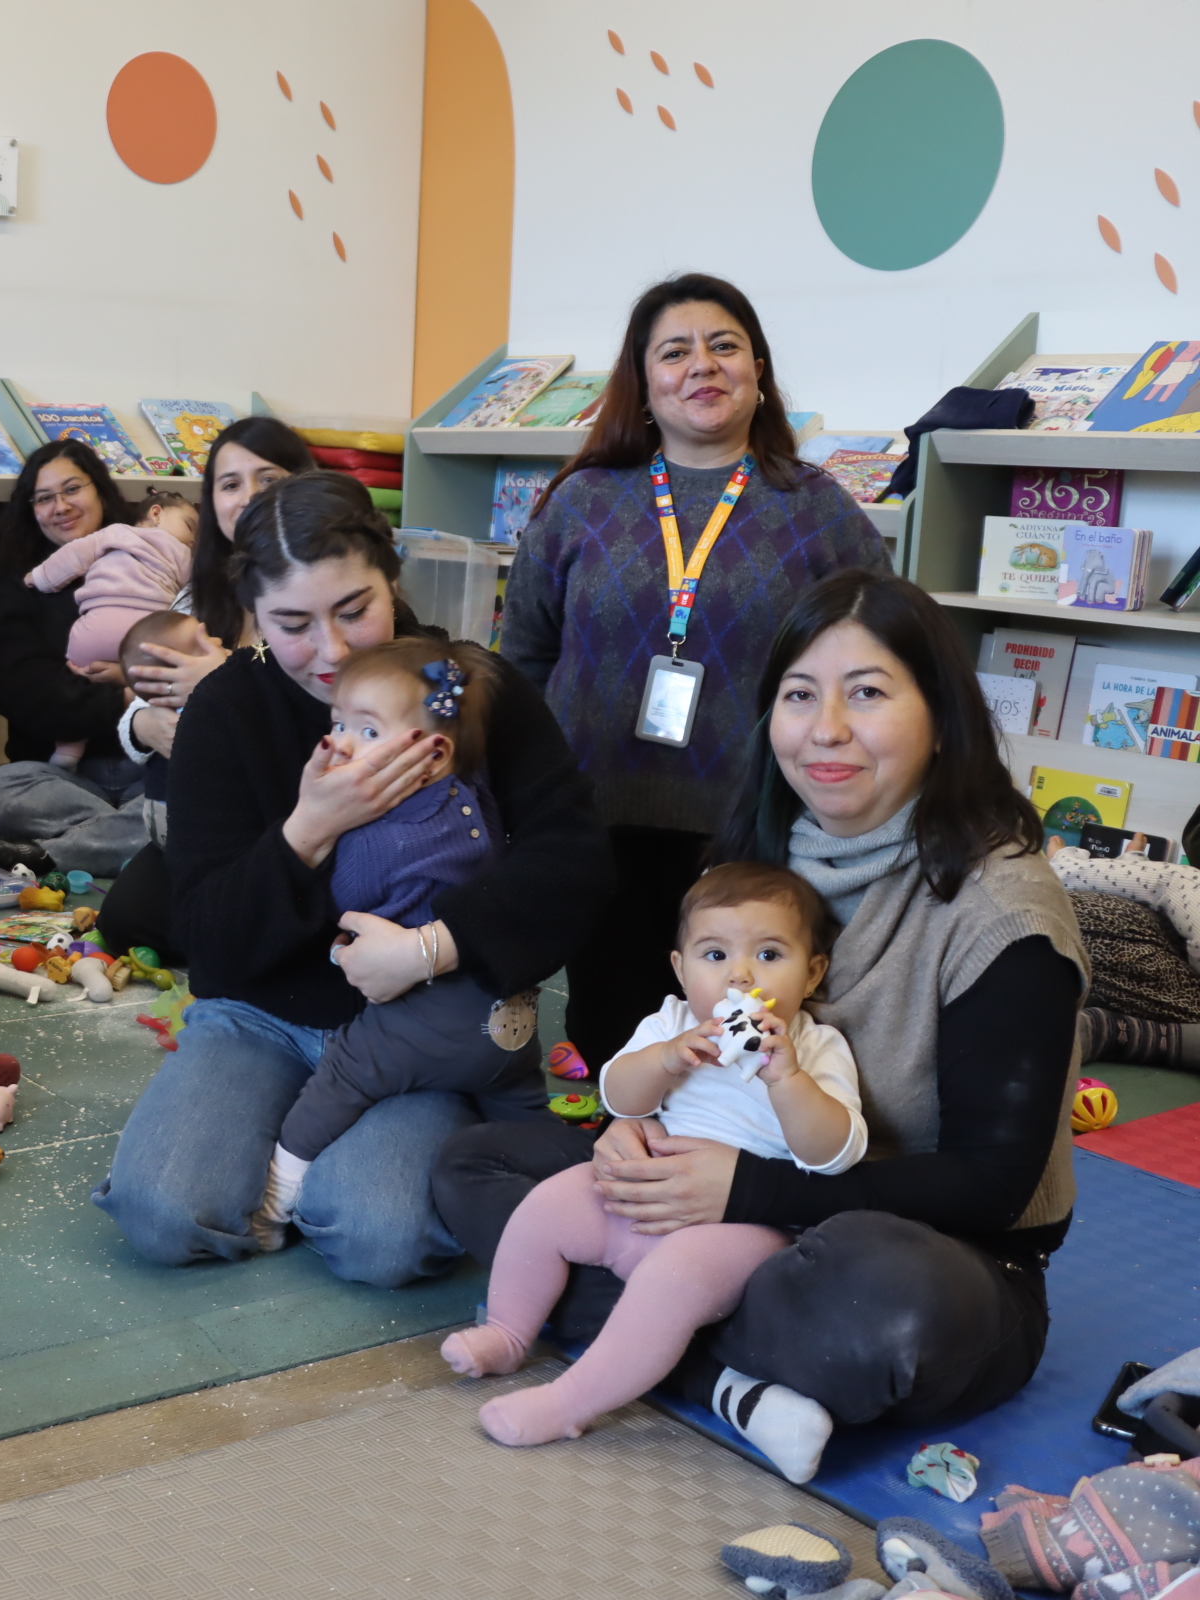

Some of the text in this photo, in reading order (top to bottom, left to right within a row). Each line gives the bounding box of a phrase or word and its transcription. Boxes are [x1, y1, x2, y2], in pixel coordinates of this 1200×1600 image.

[37, 413, 104, 422] 100 cuentos
[1018, 469, 1111, 512] 365
[1020, 524, 1058, 532] ADIVINA
[1015, 531, 1060, 541] CUÁNTO
[1075, 530, 1123, 544] En el baño
[1002, 572, 1016, 581] TE
[1005, 642, 1056, 659] PROHIBIDO
[1013, 658, 1041, 671] DECIR
[1102, 681, 1156, 696] LA HORA DE LA
